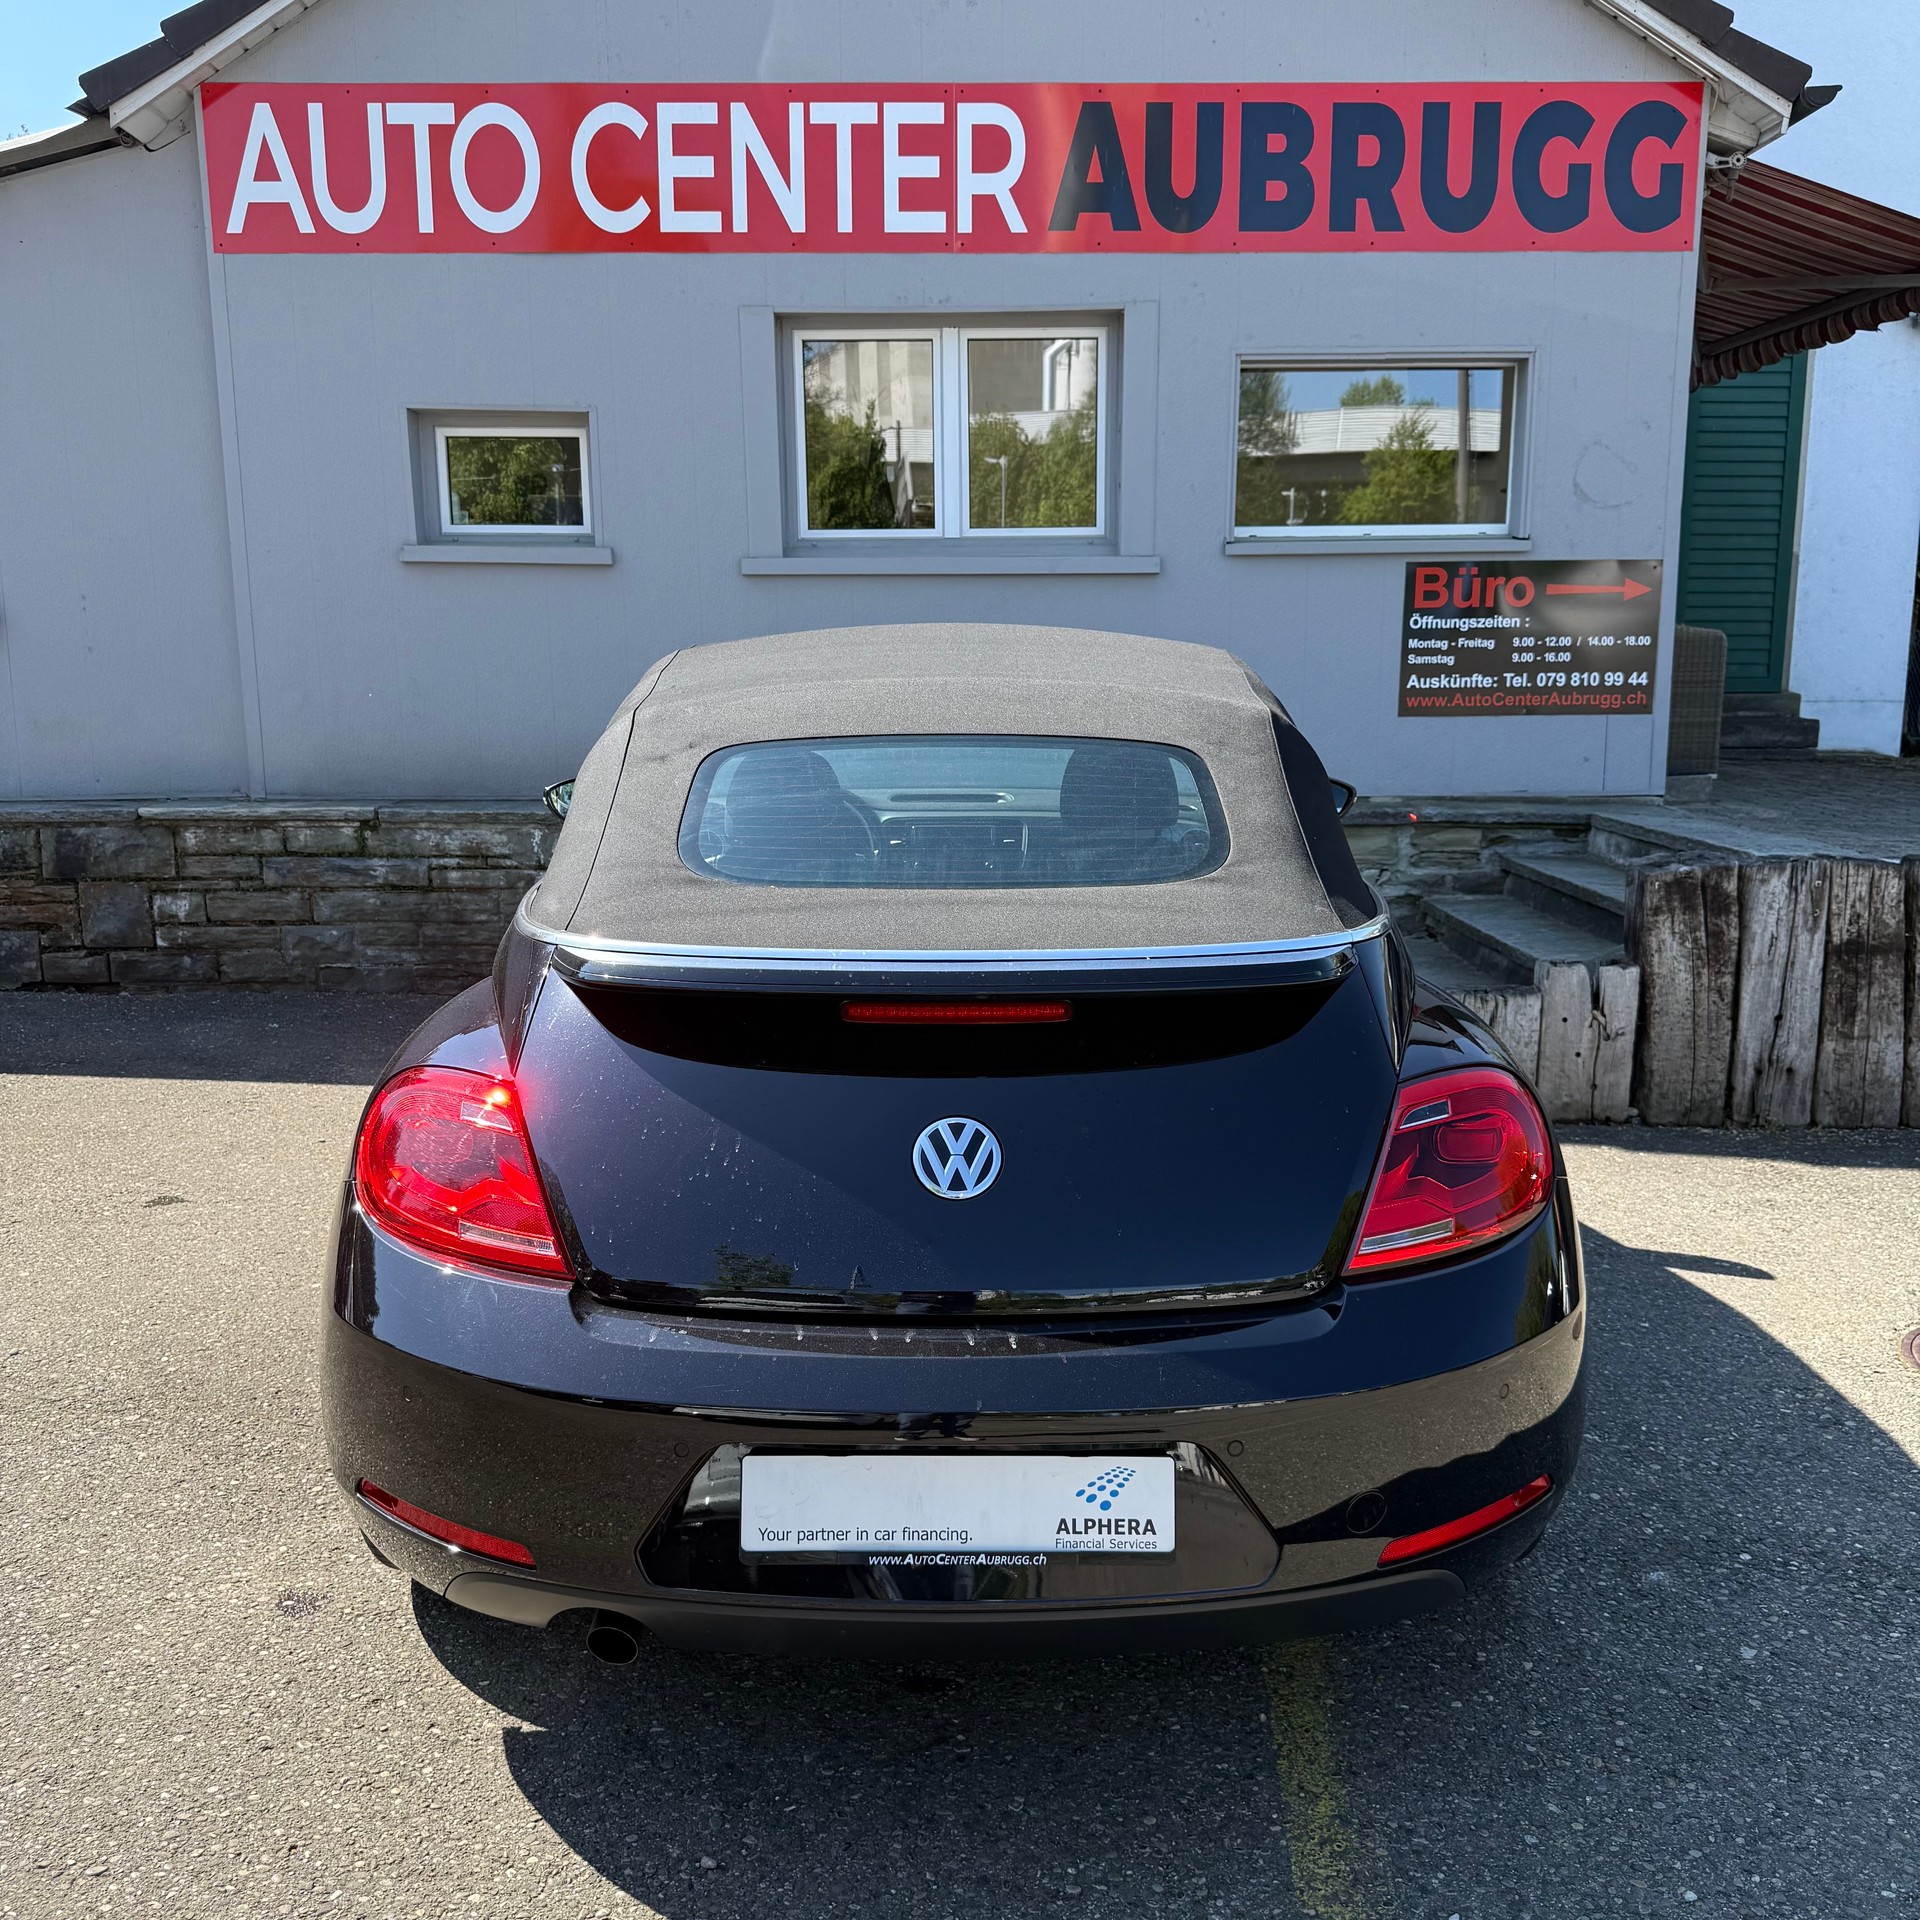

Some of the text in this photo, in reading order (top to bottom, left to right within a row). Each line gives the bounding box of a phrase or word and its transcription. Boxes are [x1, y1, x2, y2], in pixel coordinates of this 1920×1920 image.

[225, 100, 1688, 234] AUTO CENTER AUBRUGG
[1413, 567, 1536, 609] Büro
[1409, 613, 1520, 632] Öffnungszeiten
[1408, 638, 1449, 650] Montag
[1458, 637, 1496, 650] Freitag
[1512, 636, 1535, 647] 9.00
[1544, 636, 1572, 647] 12.00
[1576, 636, 1582, 647] /
[1587, 635, 1615, 646] 14.00
[1624, 635, 1651, 646] 18.00
[1407, 653, 1455, 666] Samstag
[1511, 652, 1534, 663] 9.00
[1543, 652, 1571, 662] 16.00
[1406, 671, 1648, 689] Auskünfte: Tel. 079 810 99 44
[1406, 691, 1647, 709] www.AutoCenterAubrugg.ch
[1055, 1518, 1157, 1535] ALPHERA
[758, 1527, 973, 1544] Your partner in car financing.
[1055, 1538, 1157, 1549] Financial Services
